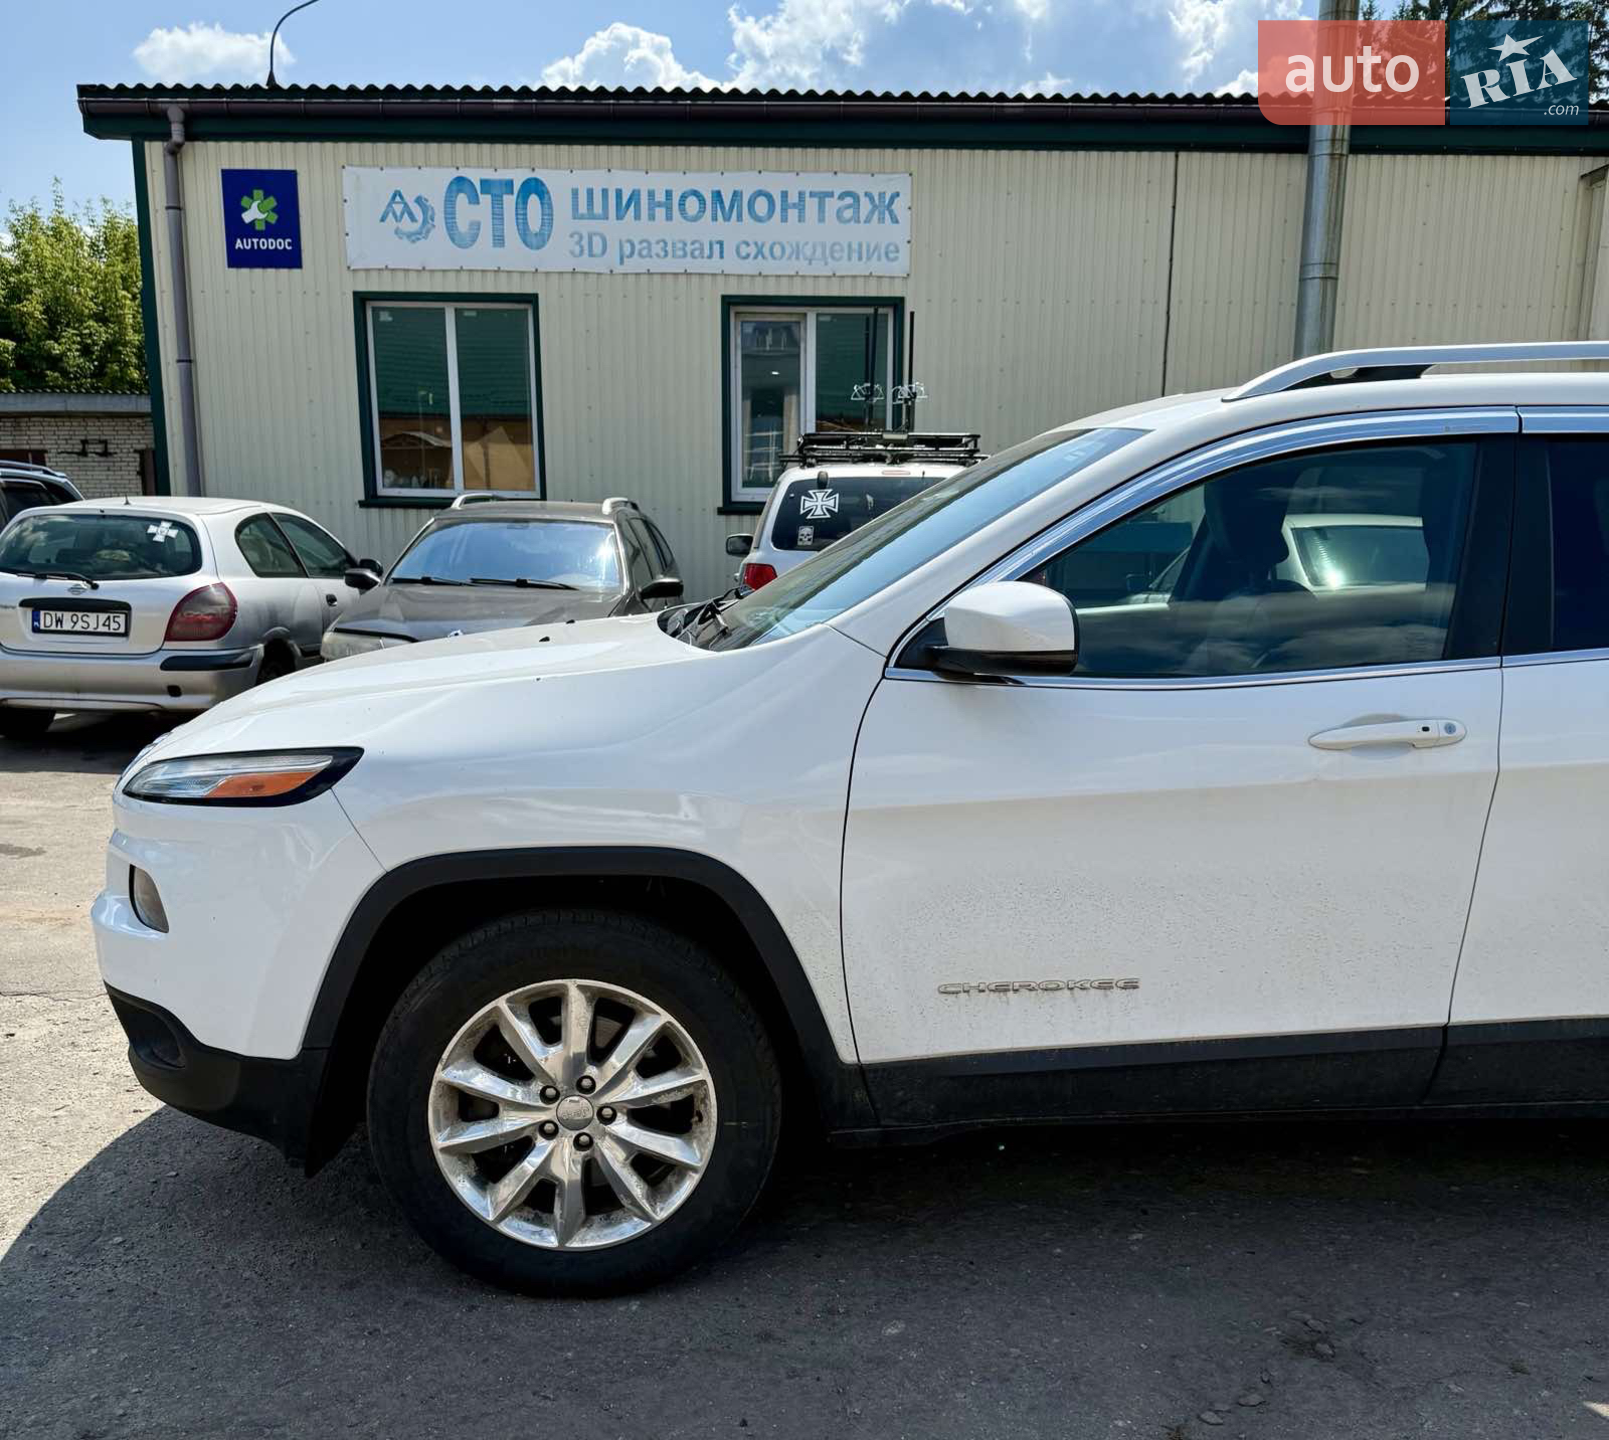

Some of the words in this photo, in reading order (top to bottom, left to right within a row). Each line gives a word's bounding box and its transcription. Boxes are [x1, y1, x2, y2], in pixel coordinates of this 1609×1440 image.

[443, 175, 554, 251] СТО
[234, 237, 293, 251] AUTODOC
[568, 230, 608, 260] 3D
[618, 238, 726, 266] развал
[734, 238, 900, 267] схождение
[43, 611, 64, 629] DW
[70, 613, 122, 632] 9SJ45
[937, 977, 1140, 995] CHEROKEE
